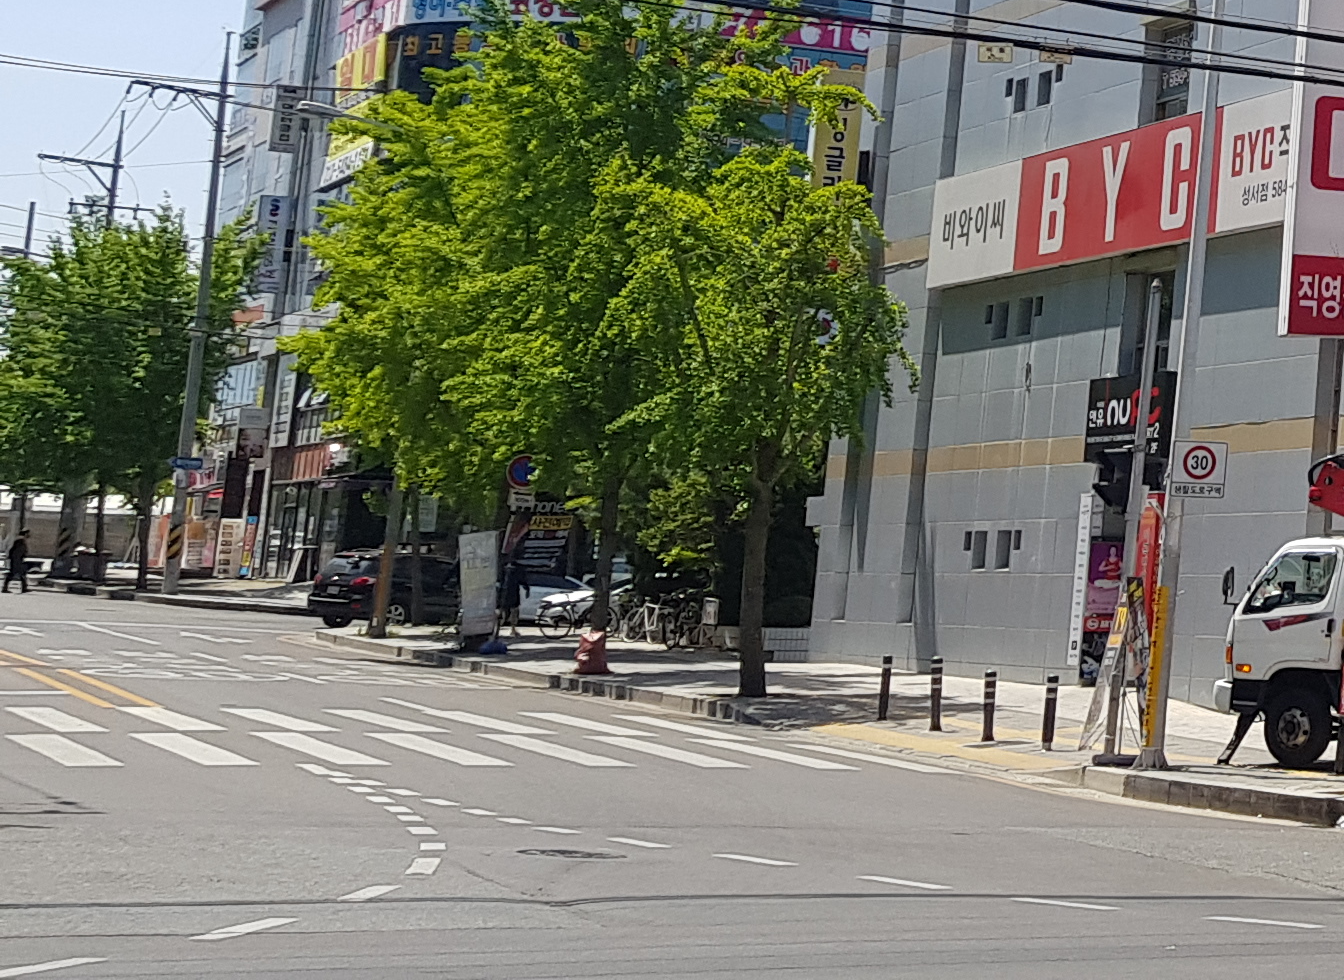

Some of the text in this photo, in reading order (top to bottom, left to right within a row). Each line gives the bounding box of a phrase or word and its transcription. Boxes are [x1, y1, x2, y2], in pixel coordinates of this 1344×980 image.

[1230, 126, 1276, 178] BYC
[1038, 126, 1194, 257] BYC
[1241, 183, 1269, 208] 성서점
[943, 196, 1006, 252] 비와이씨
[1190, 454, 1209, 471] 30
[1174, 484, 1222, 496] 생활도로구역
